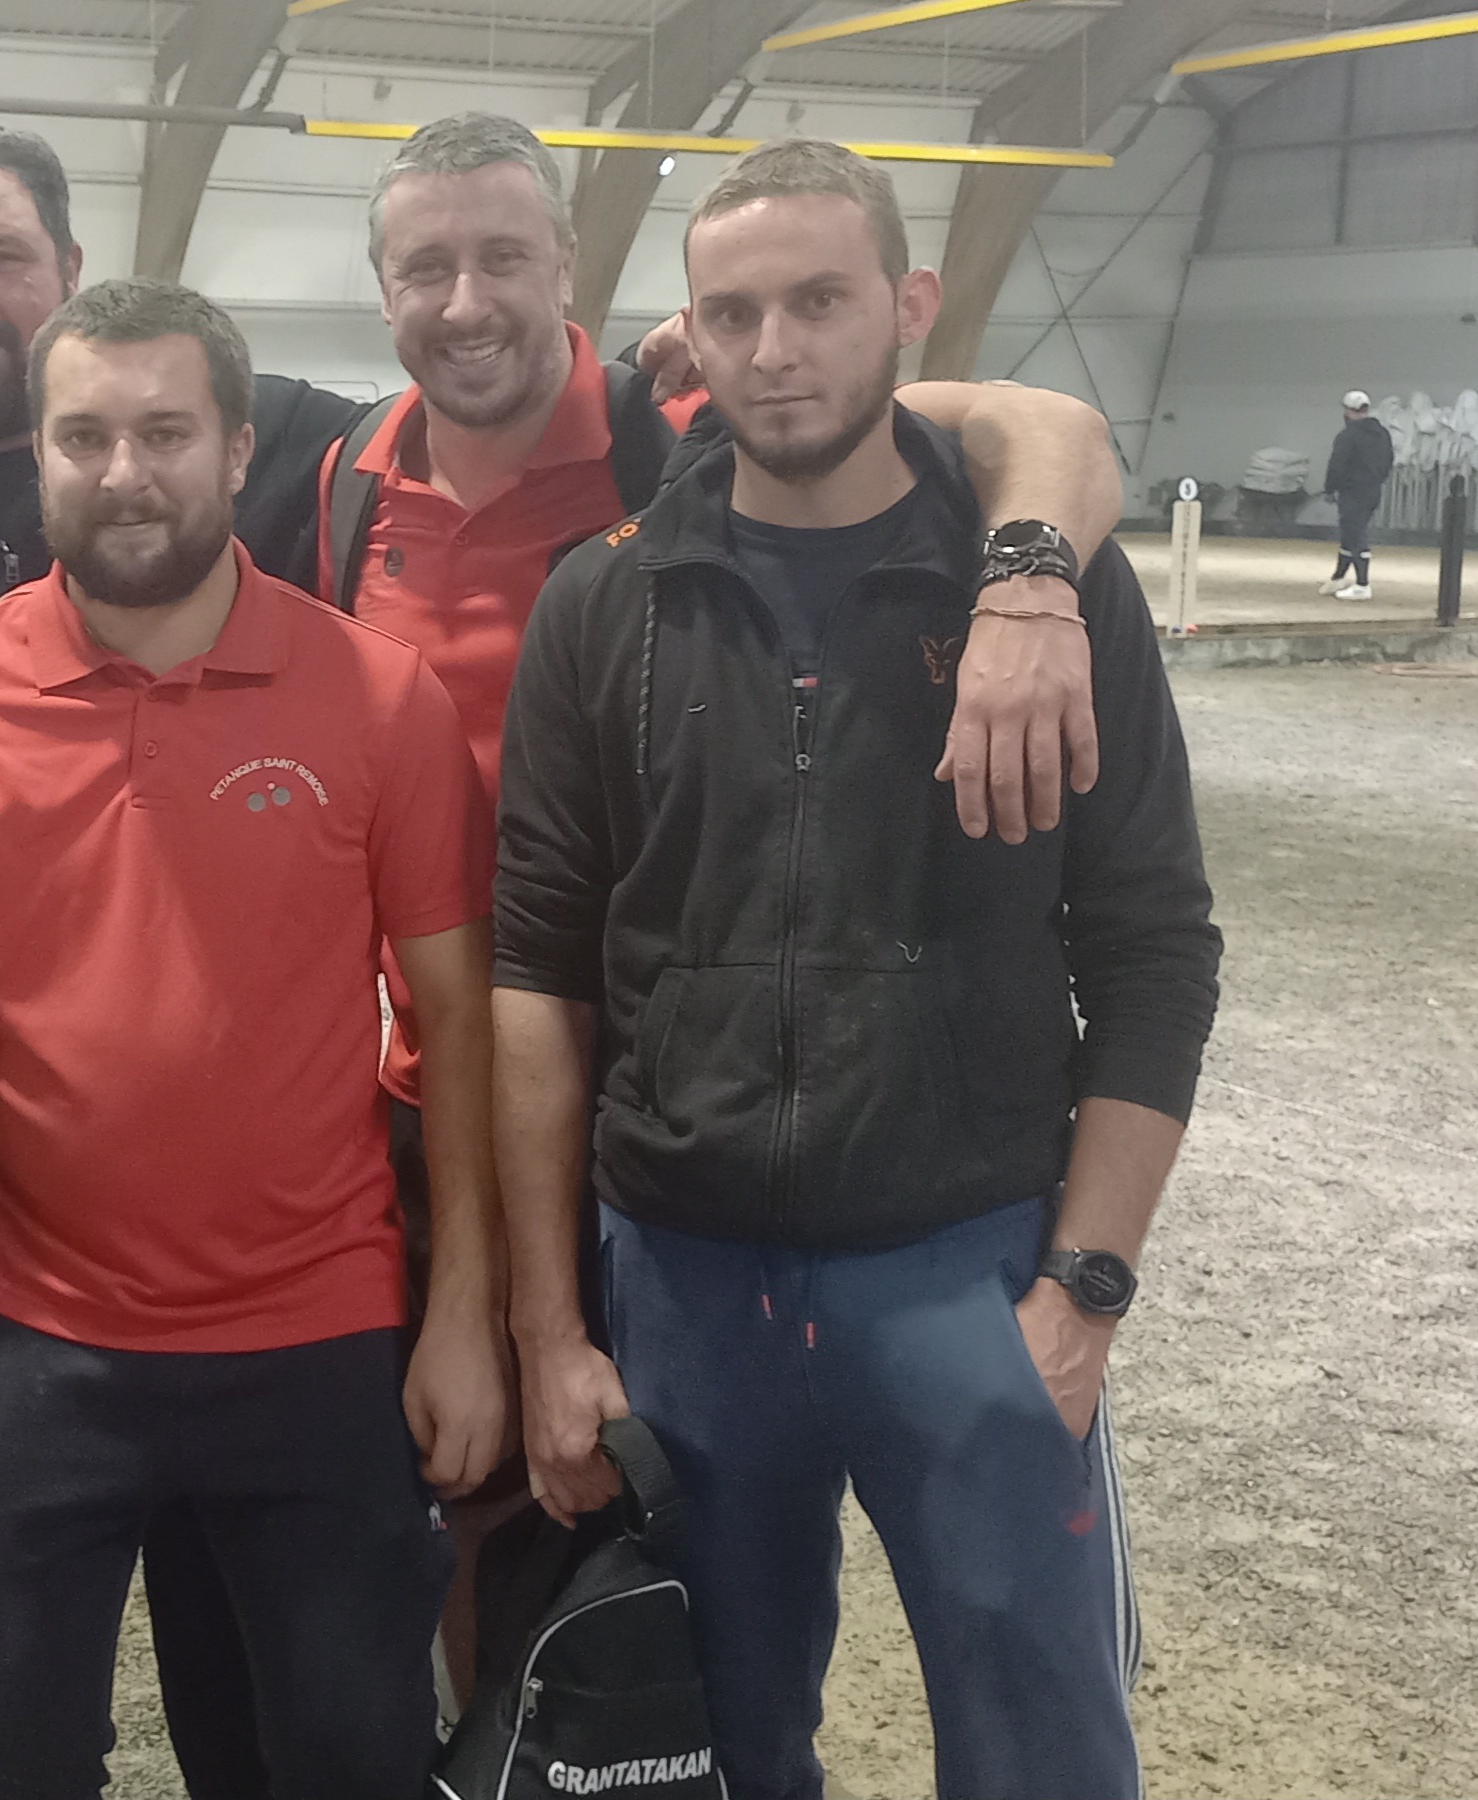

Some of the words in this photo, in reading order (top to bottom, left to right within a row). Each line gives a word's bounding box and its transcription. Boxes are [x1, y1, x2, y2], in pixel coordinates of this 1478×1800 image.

[209, 758, 263, 801] PETANQUE
[263, 757, 298, 771] SAINT
[547, 1747, 712, 1795] GRANTATAKAN
